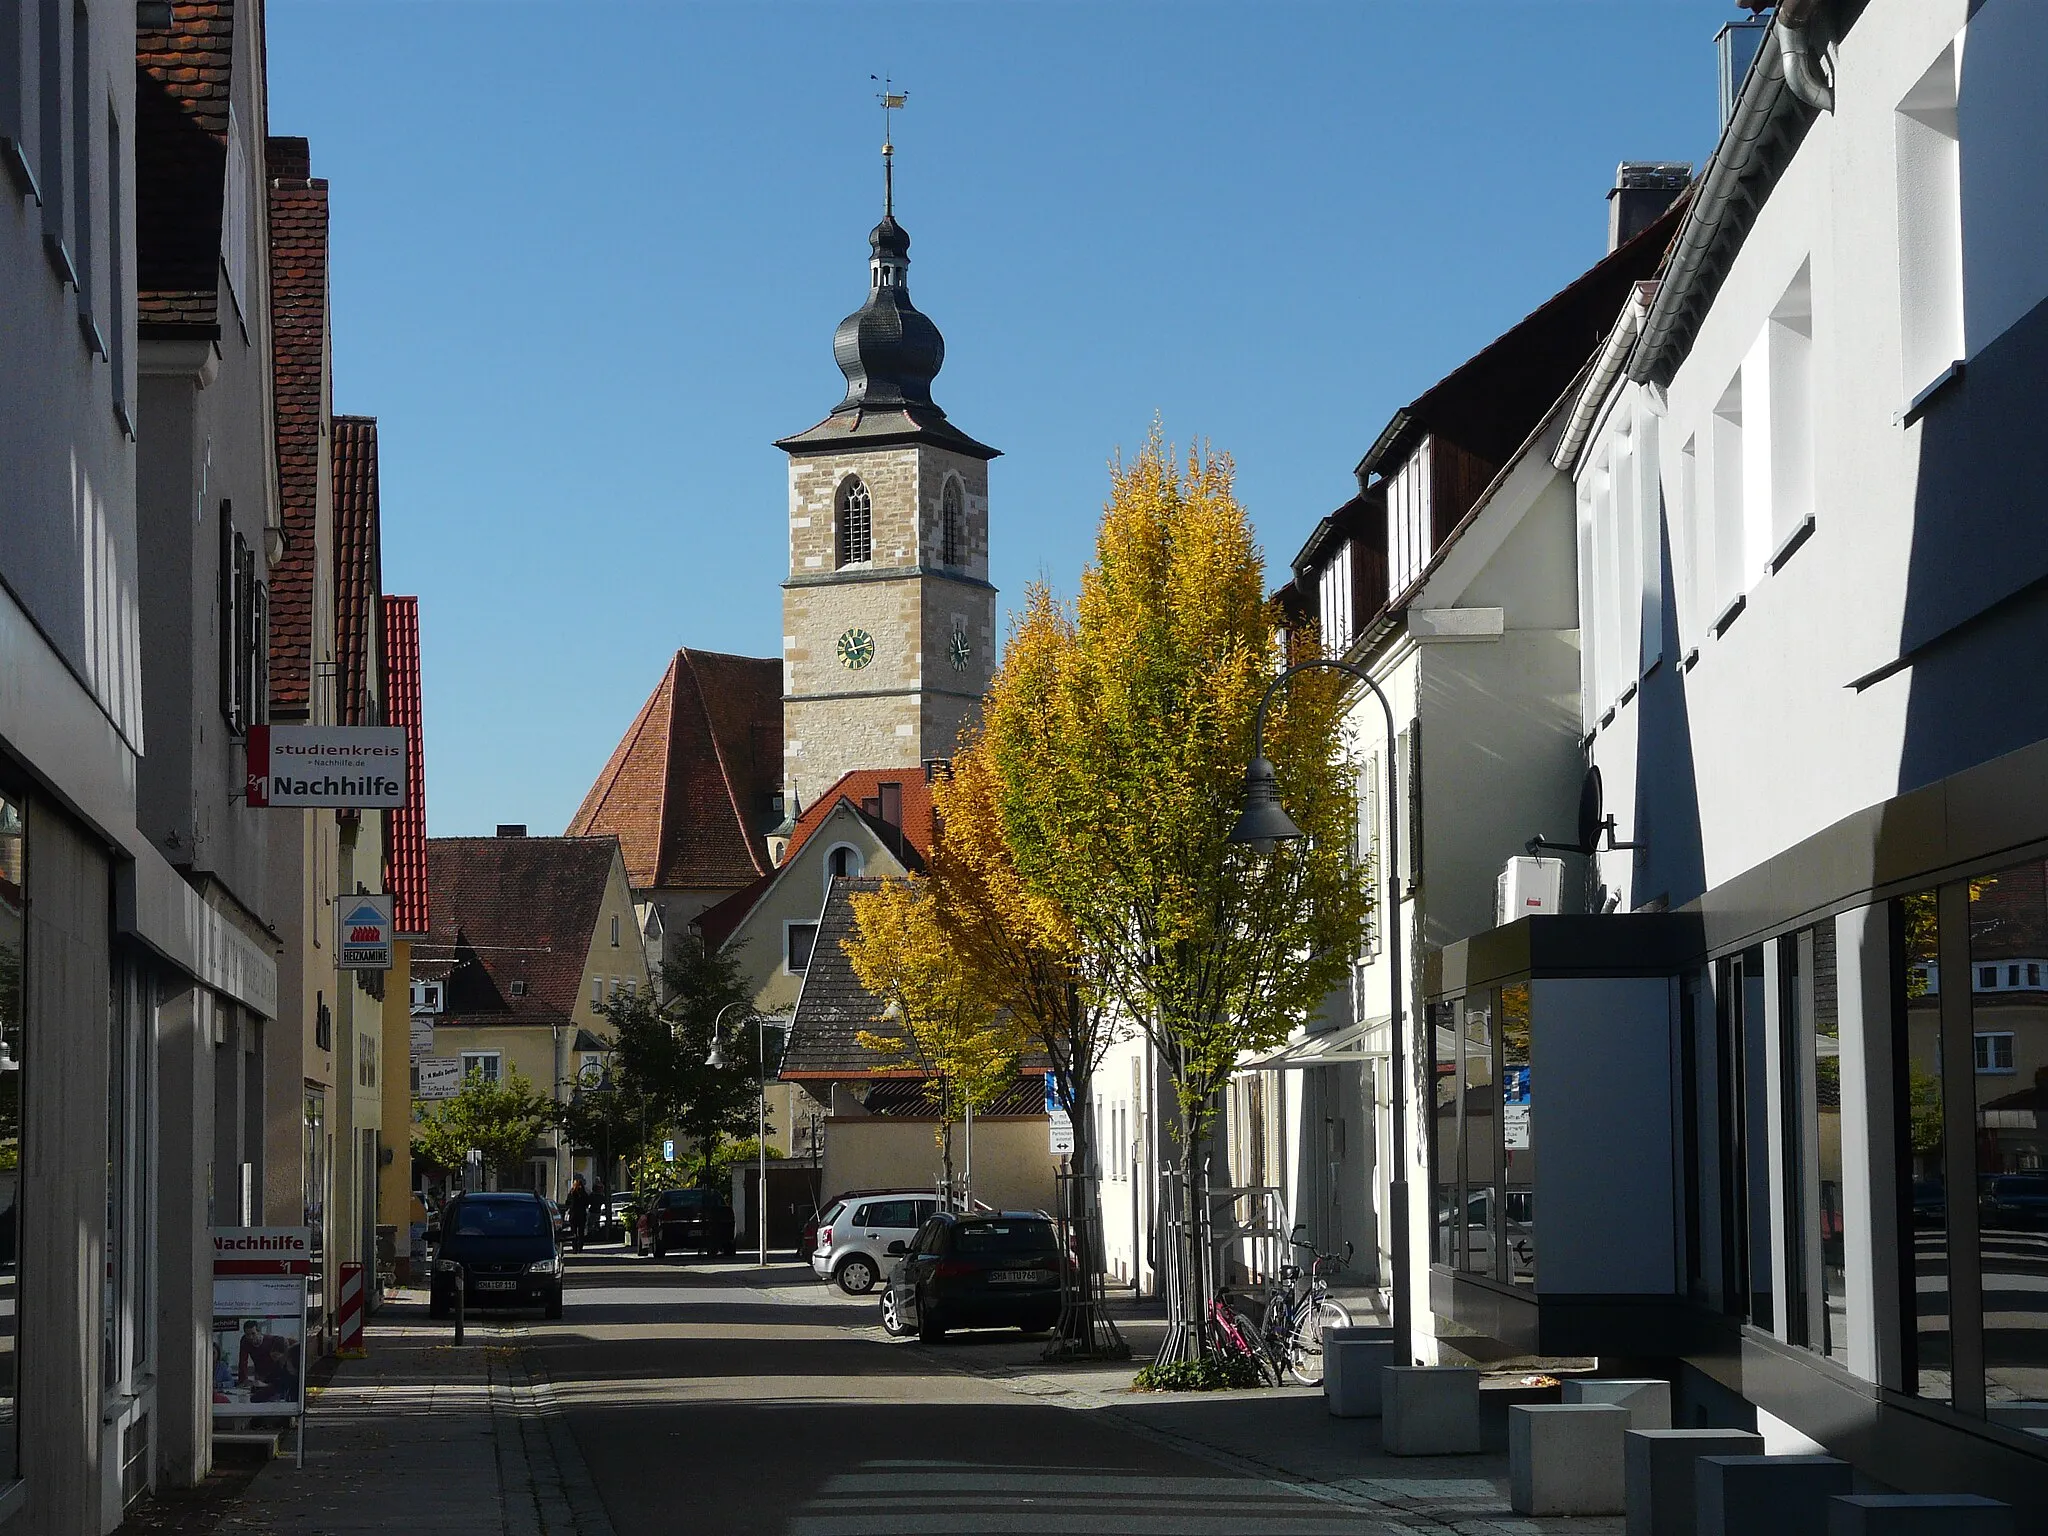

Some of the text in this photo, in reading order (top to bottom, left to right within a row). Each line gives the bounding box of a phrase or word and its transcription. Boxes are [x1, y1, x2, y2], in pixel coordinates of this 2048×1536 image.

[274, 744, 400, 757] studienkreis
[273, 776, 399, 796] Nachhilfe
[343, 950, 388, 961] HEIZKAMINE
[667, 1142, 674, 1157] P
[213, 1235, 304, 1250] Nachhilfe
